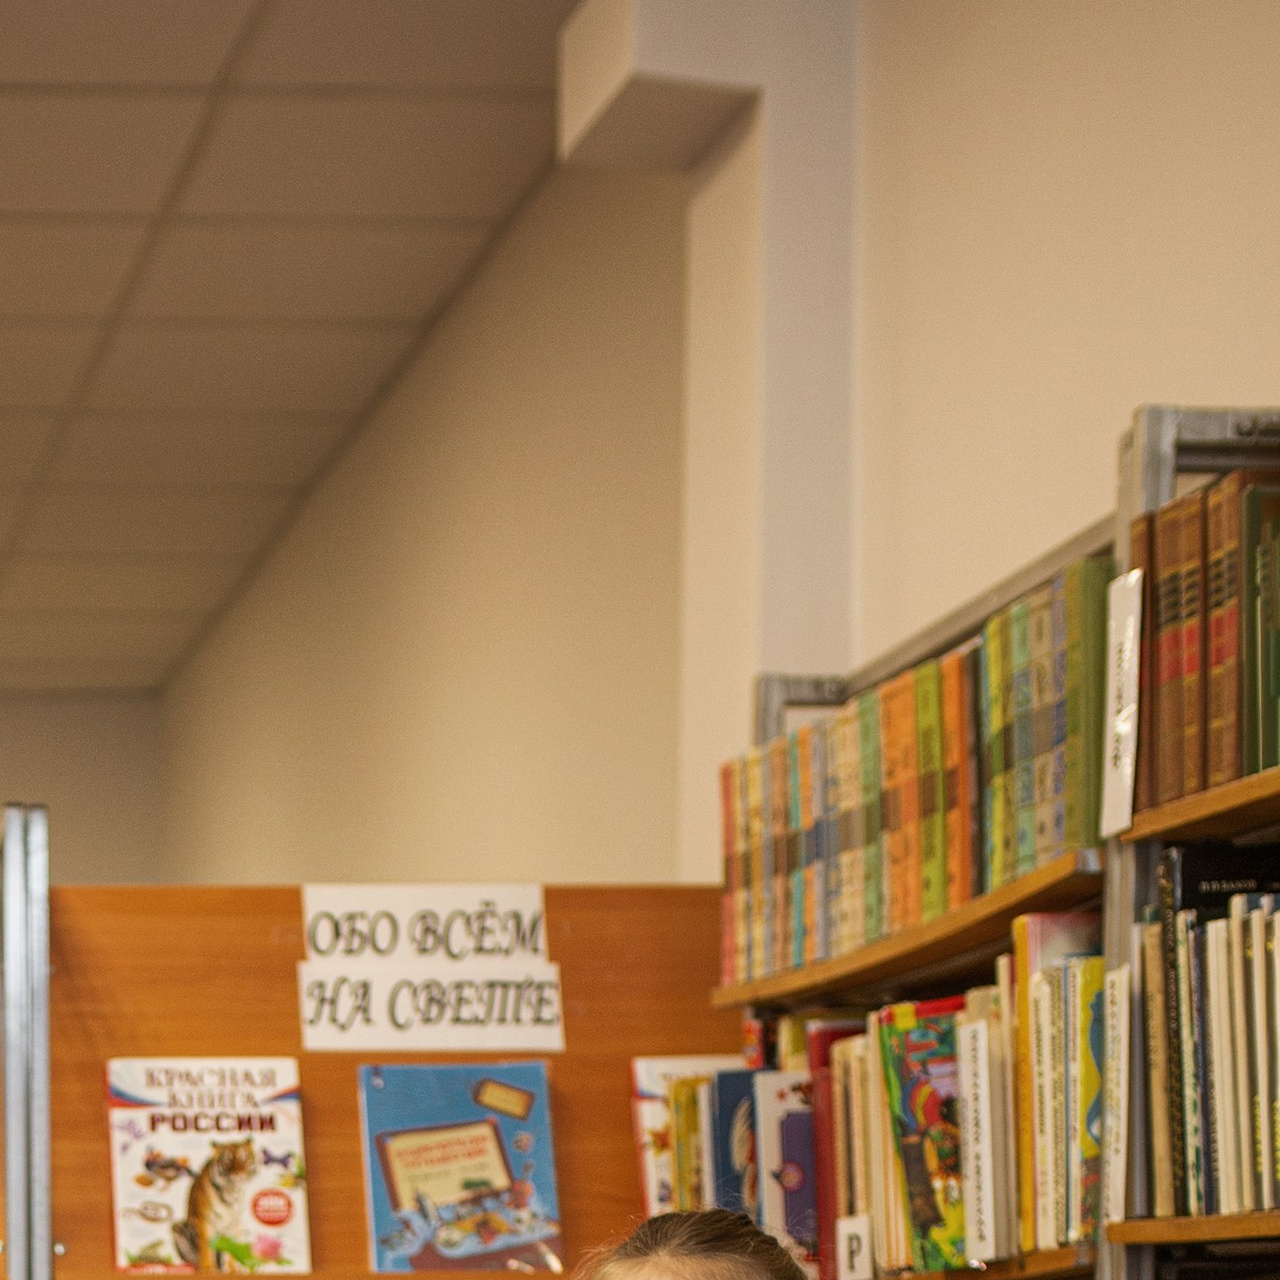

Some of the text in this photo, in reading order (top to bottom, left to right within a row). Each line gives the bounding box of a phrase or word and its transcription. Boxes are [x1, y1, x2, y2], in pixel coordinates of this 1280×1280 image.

[307, 899, 544, 960] ОБО ВСЁМ
[306, 978, 560, 1031] НА СВЕТЕ
[144, 1067, 278, 1088] КРАСНАЯ
[166, 1090, 261, 1109] КНИГА
[149, 1112, 276, 1132] РОССИИ
